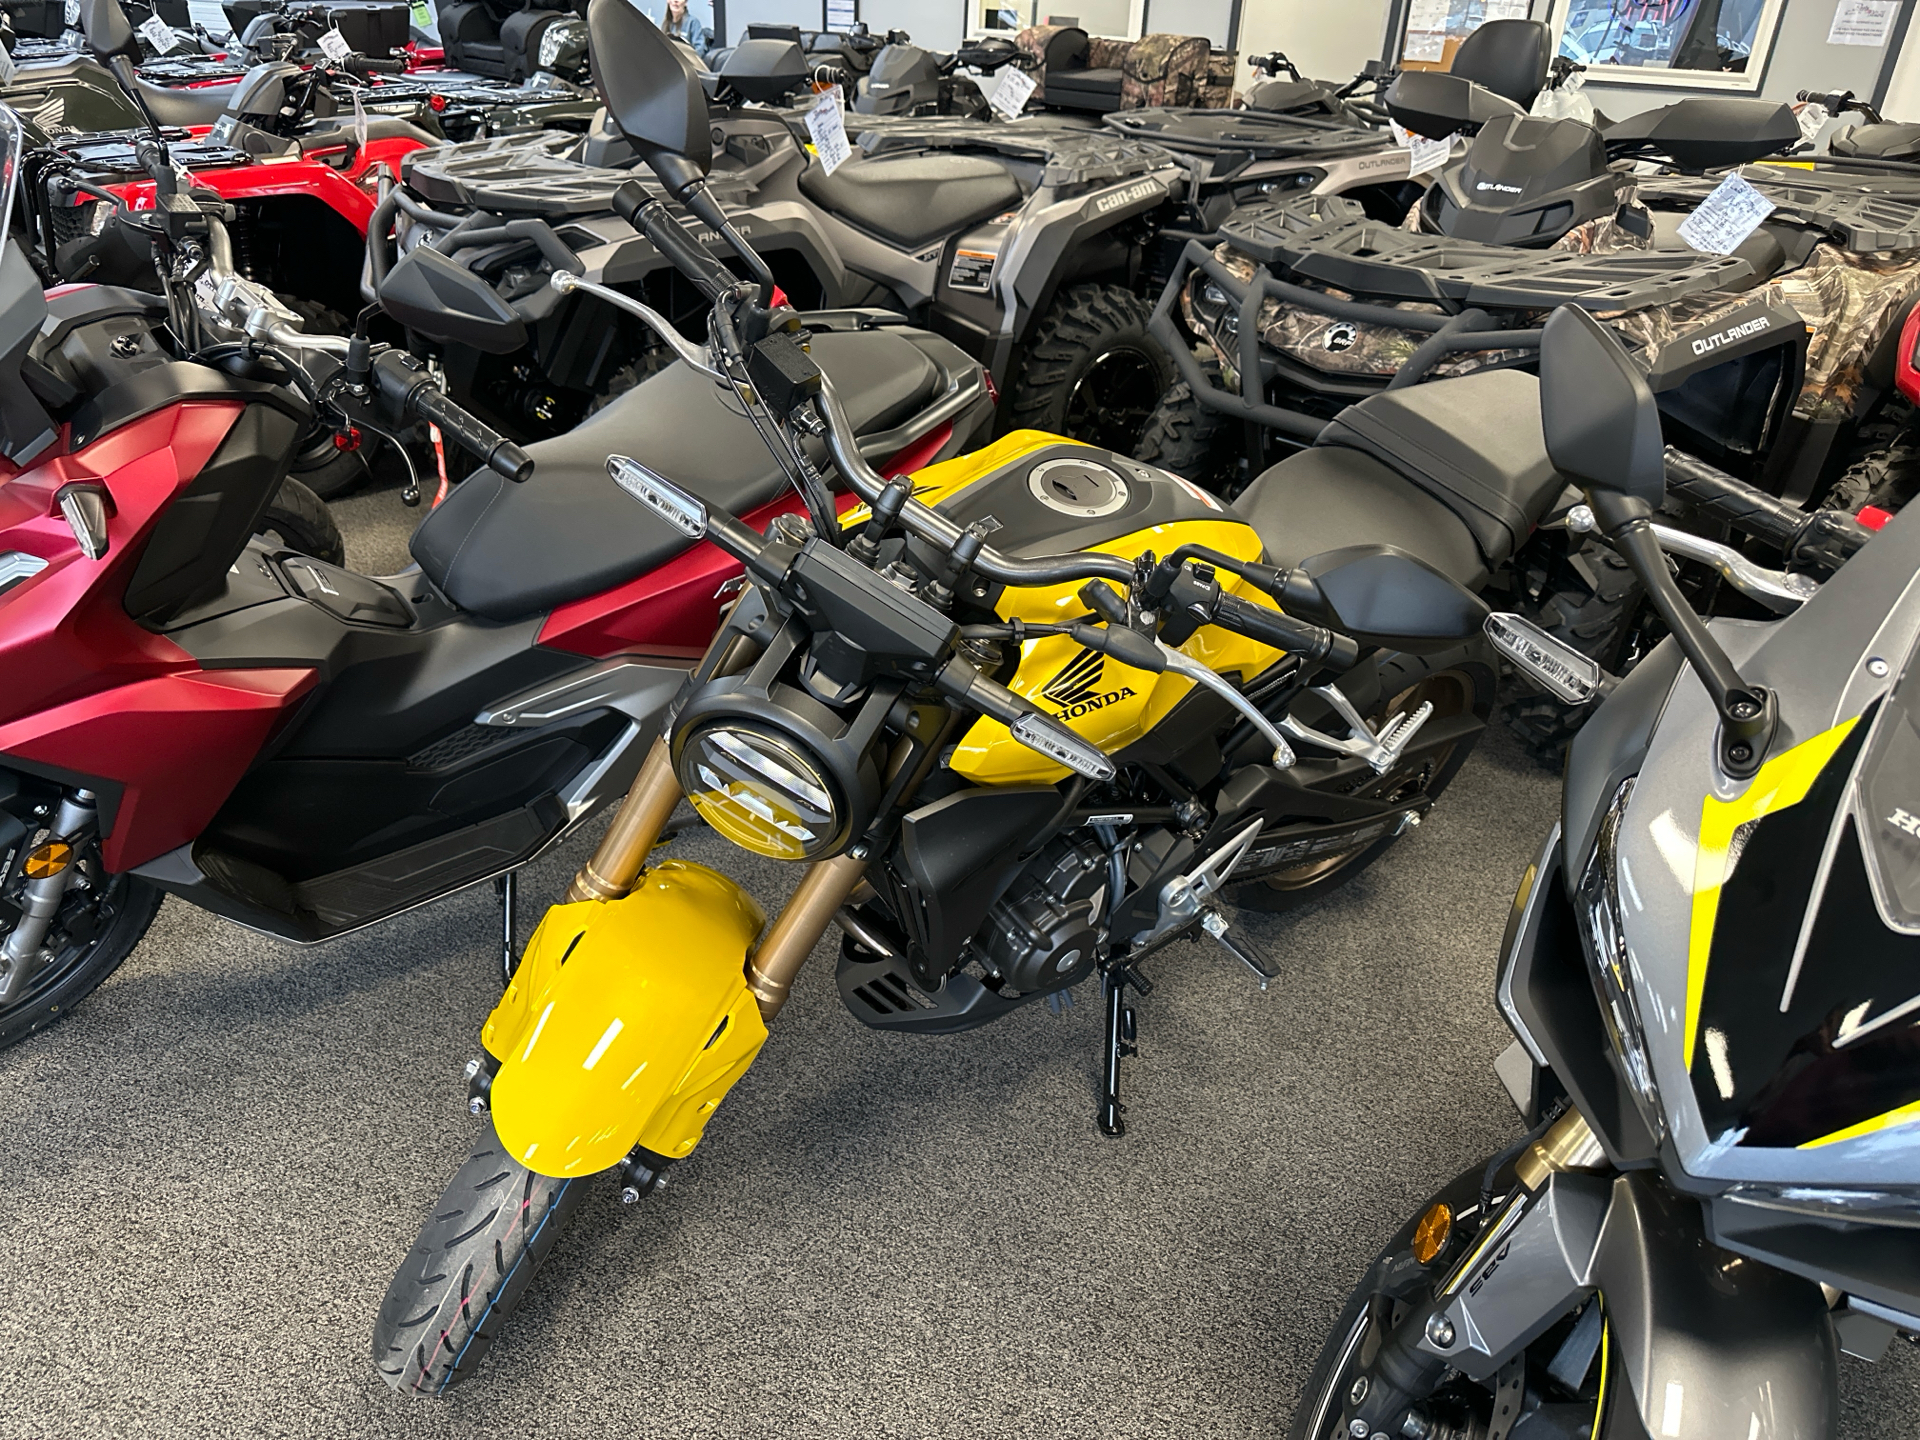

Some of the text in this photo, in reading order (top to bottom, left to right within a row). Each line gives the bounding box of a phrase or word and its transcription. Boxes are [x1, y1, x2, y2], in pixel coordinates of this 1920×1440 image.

[1358, 156, 1407, 170] OUTLANDER
[1096, 180, 1157, 212] can-am
[1691, 316, 1771, 355] OUTLANDER
[1053, 686, 1138, 722] HONDA
[1887, 807, 1920, 839] H
[1469, 1239, 1512, 1298] ABS
